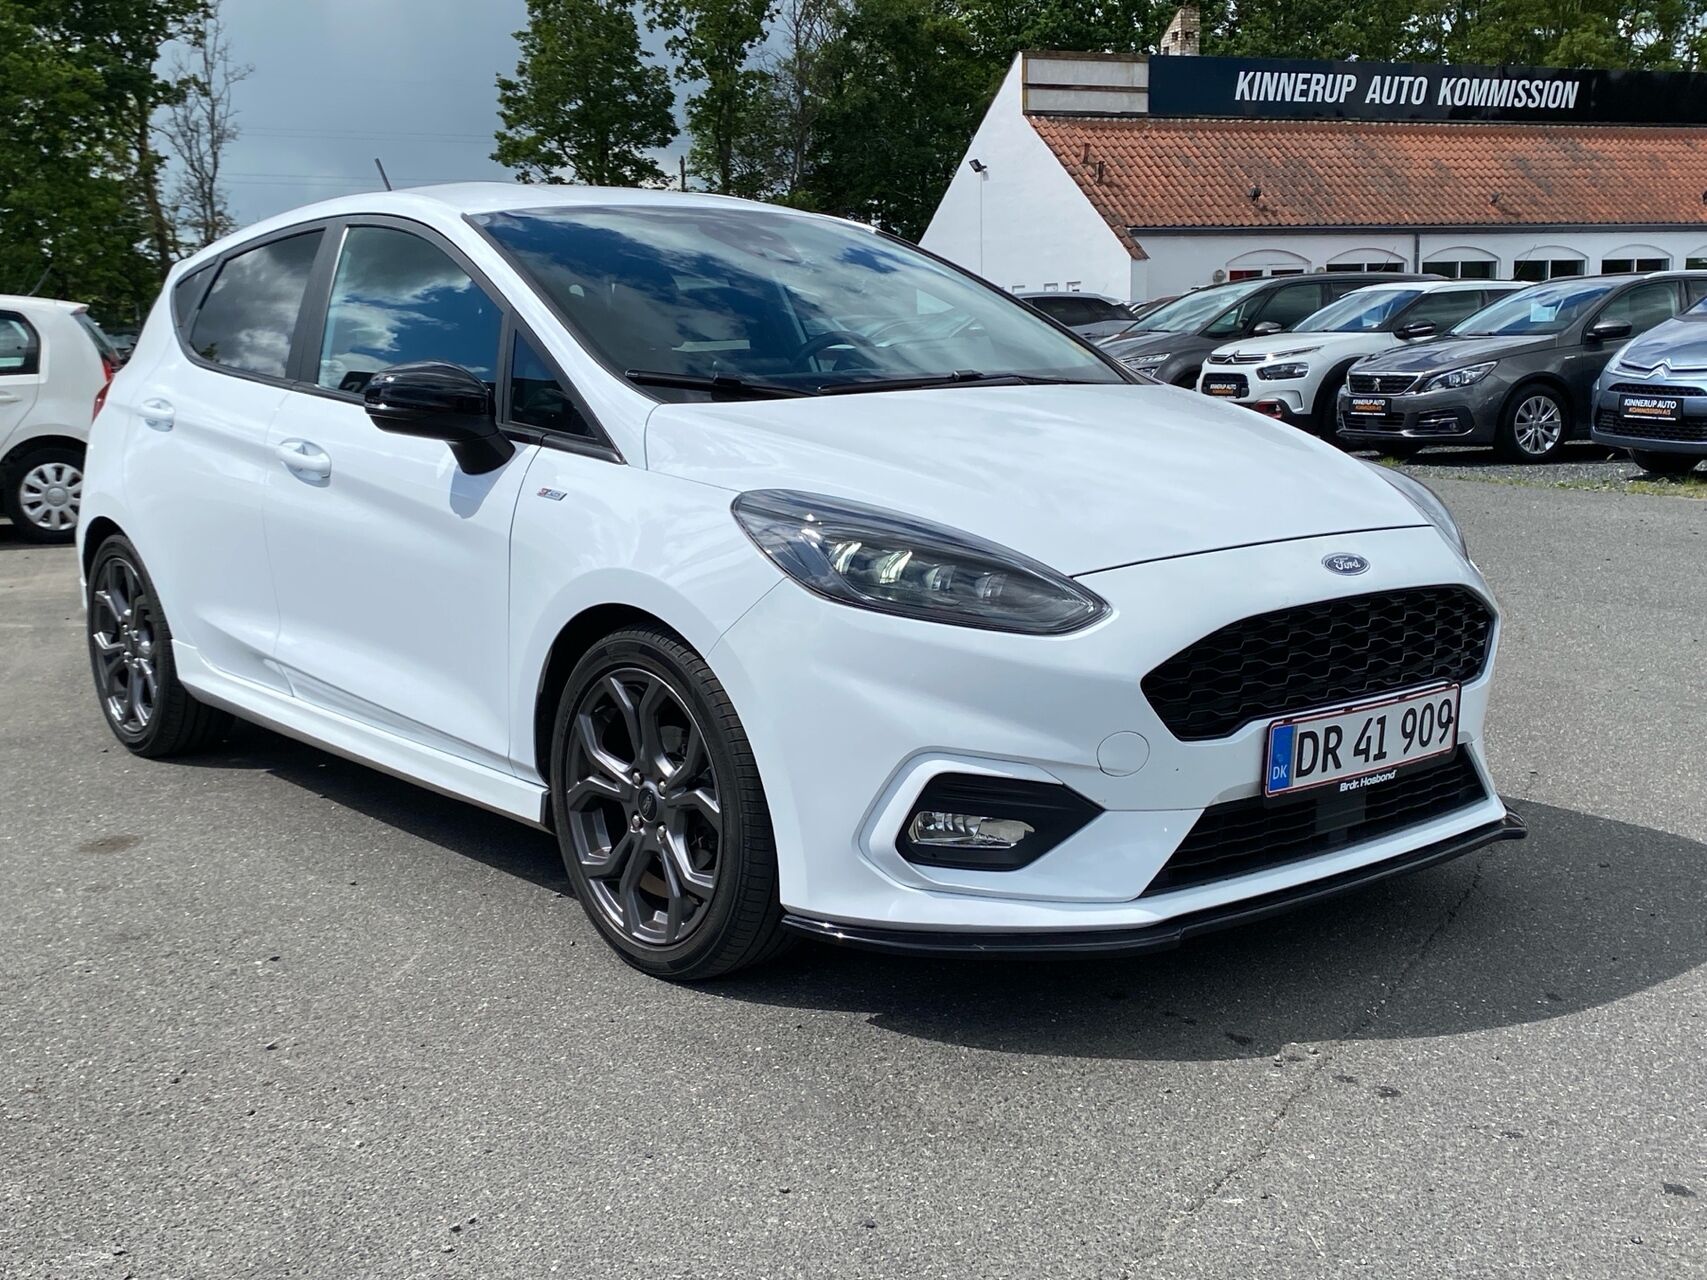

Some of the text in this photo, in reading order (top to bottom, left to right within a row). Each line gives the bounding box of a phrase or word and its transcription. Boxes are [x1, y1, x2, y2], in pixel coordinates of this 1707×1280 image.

[1234, 71, 1580, 109] KINNERUP AUTO KOMMISSION
[1624, 398, 1677, 409] KINNERUP AUTO
[1333, 557, 1361, 570] Ford
[1272, 698, 1453, 781] DK DR 41 909
[1340, 780, 1360, 792] Brdr.
